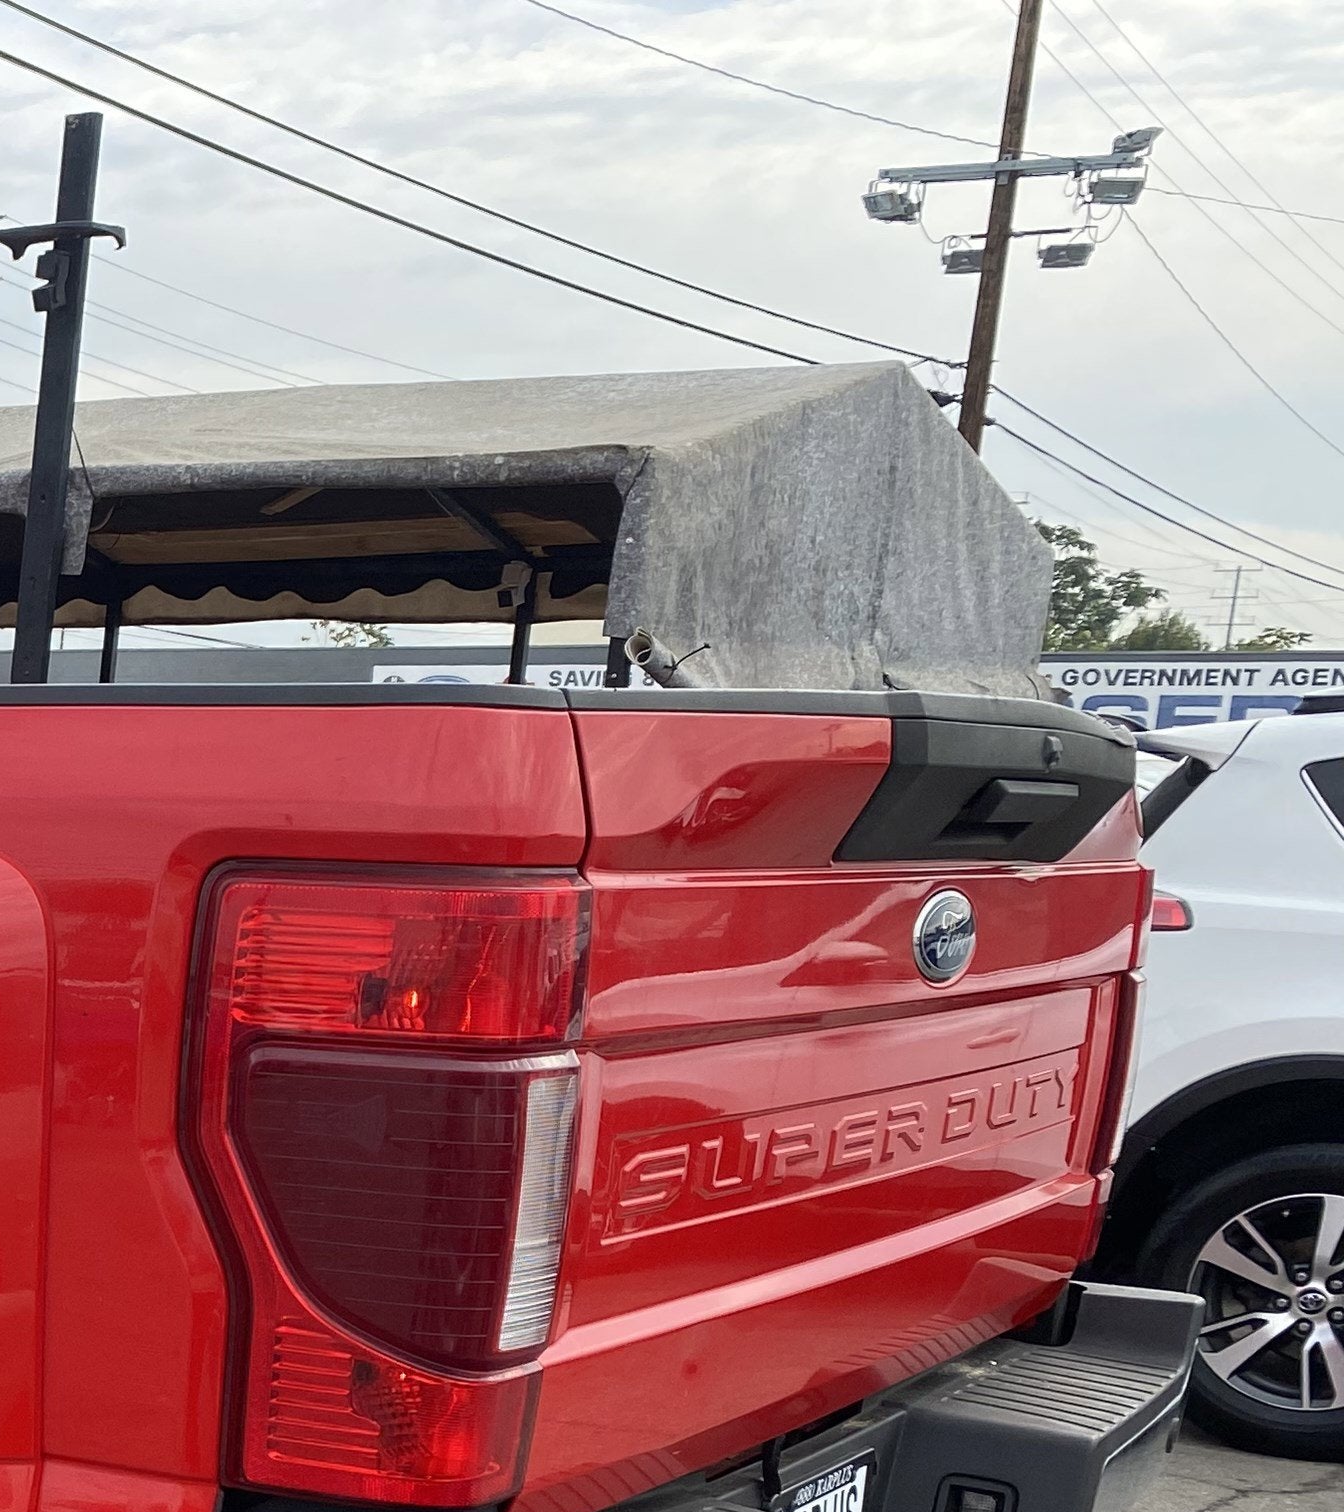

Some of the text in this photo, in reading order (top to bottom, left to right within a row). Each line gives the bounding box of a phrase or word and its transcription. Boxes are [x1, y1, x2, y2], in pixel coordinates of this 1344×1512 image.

[549, 670, 632, 687] SAVI
[1061, 667, 1261, 687] GOVERNMENT
[616, 1062, 1078, 1220] SUPER DUTY
